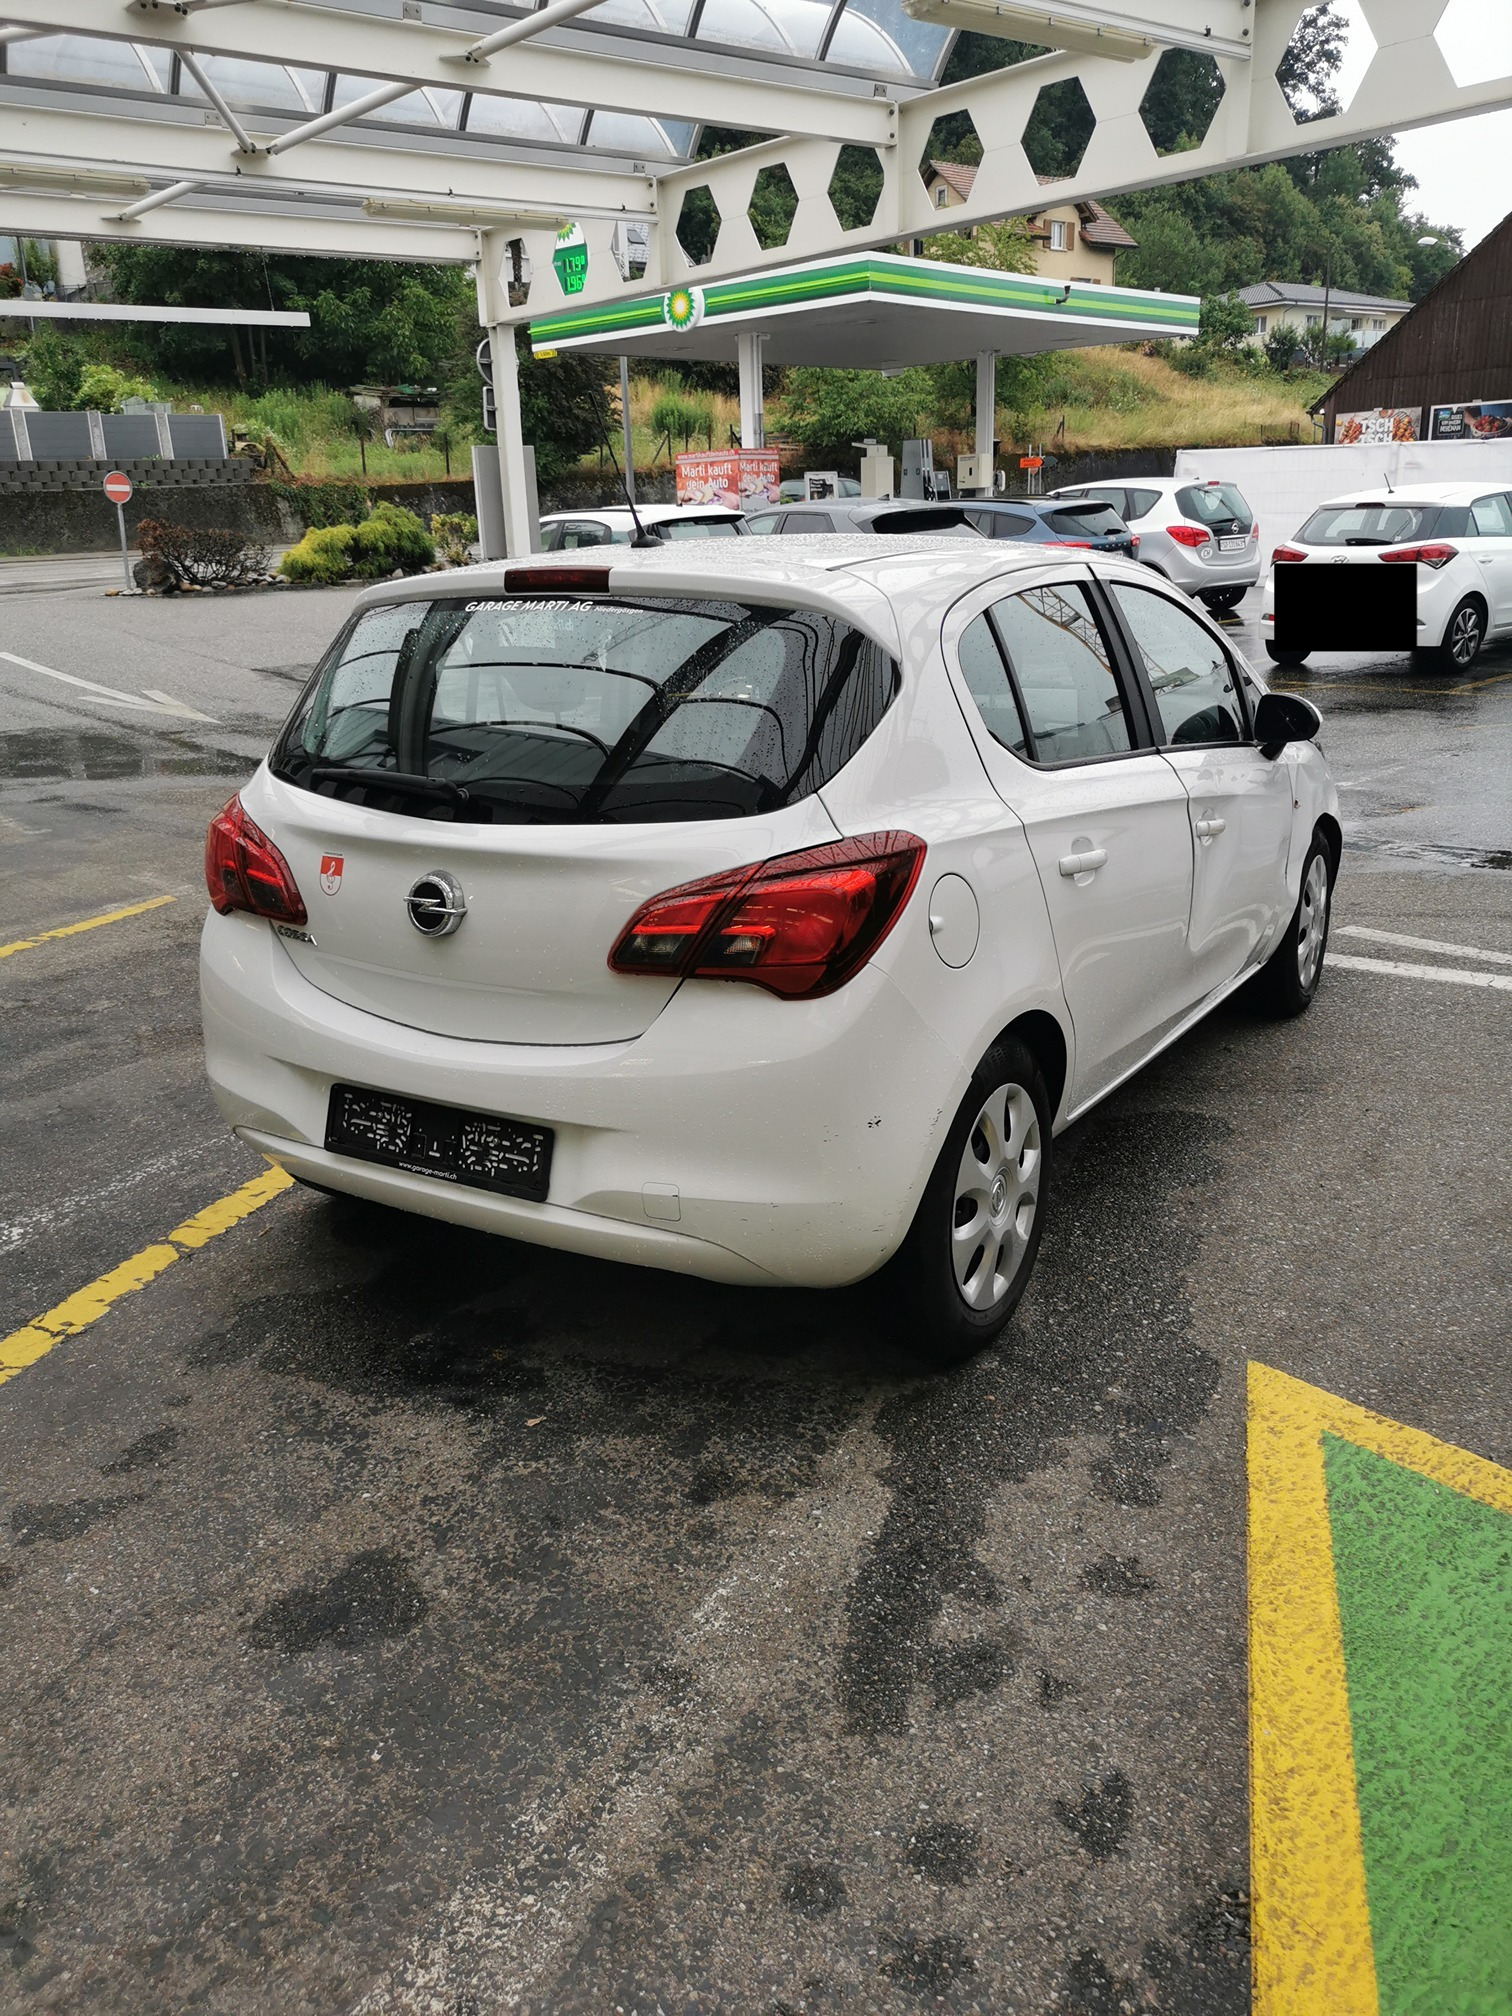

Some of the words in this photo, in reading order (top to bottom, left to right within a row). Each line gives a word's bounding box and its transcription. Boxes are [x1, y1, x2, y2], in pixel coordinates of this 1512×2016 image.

[1361, 417, 1394, 433] TSCH
[681, 464, 705, 478] Marti
[707, 462, 732, 476] kauft
[739, 461, 758, 472] Marti
[759, 460, 778, 472] kauft
[686, 479, 705, 490] dein
[708, 477, 728, 489] Auto
[742, 473, 757, 482] dein
[759, 472, 775, 483] Auto
[1203, 549, 1211, 557] CH
[464, 600, 523, 612] GARAGE
[521, 600, 569, 611] MARTI
[568, 601, 594, 612] AG
[277, 924, 318, 946] CORSA
[398, 1161, 458, 1180] www.garage-marti.ch
